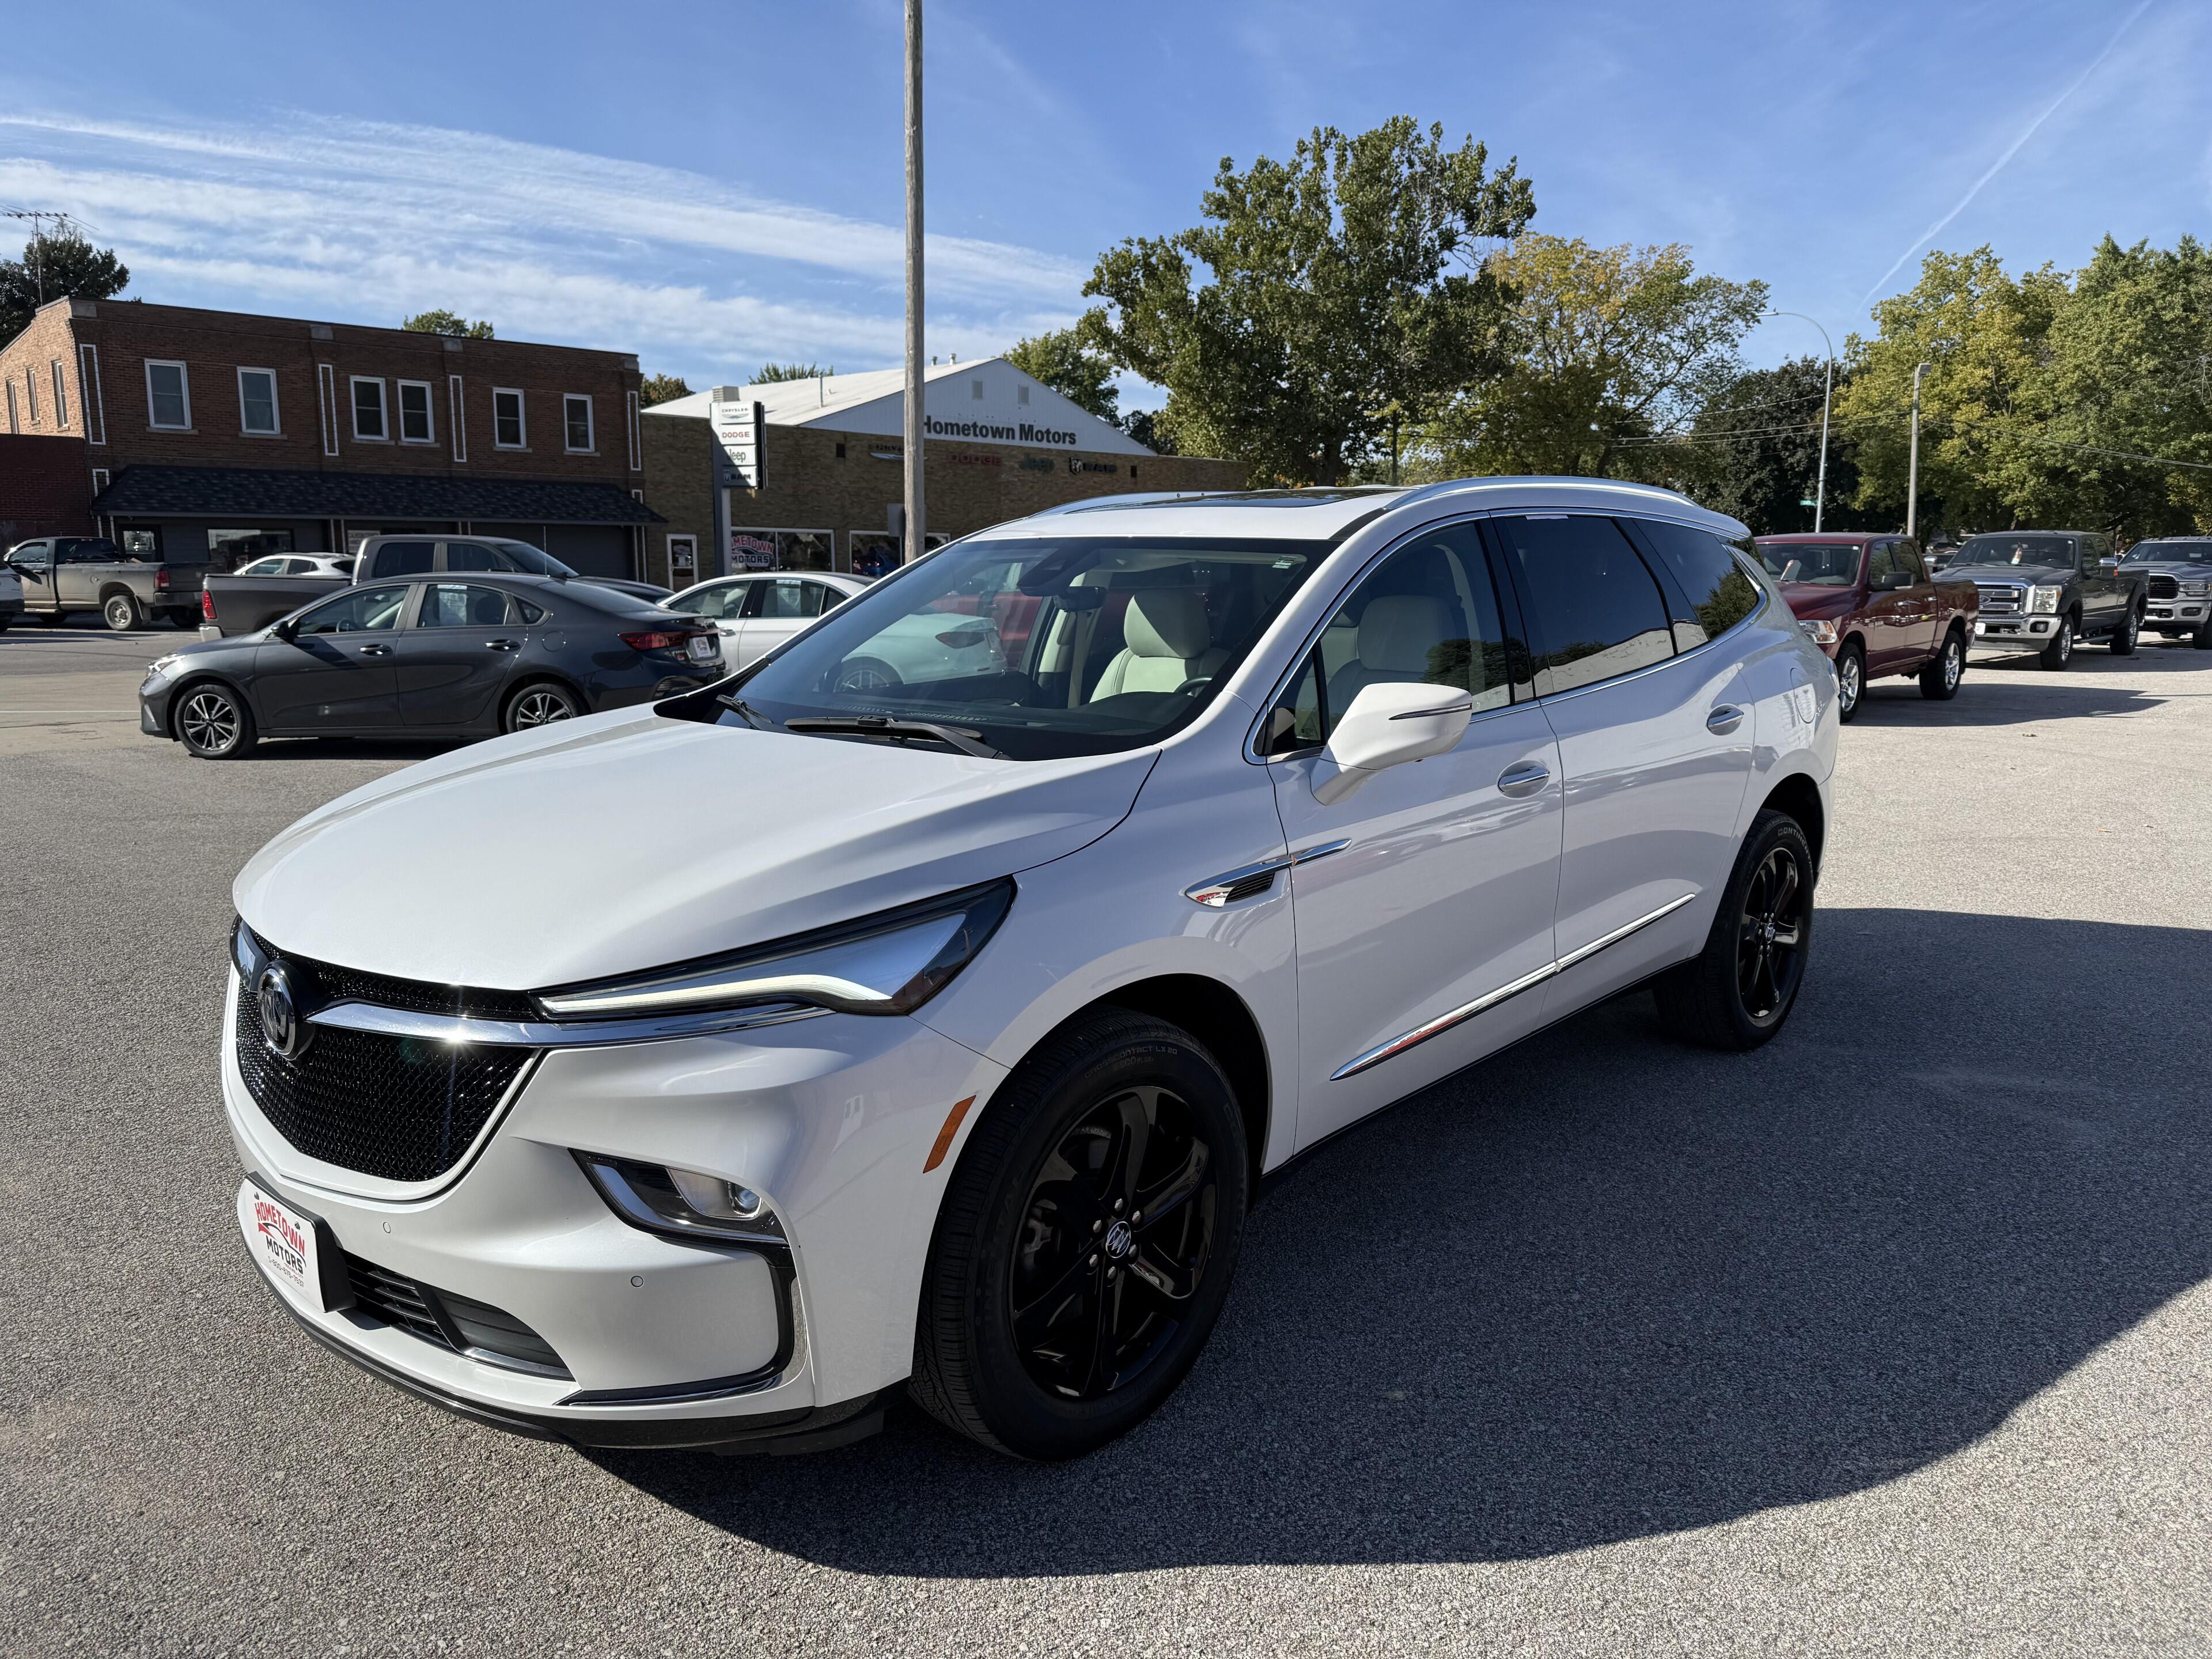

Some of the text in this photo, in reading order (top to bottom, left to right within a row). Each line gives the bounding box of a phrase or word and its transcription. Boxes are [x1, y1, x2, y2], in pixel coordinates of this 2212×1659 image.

[924, 415, 1077, 445] Hometown Motors
[728, 448, 746, 463] Jeep
[732, 536, 774, 553] METOWN
[732, 555, 769, 563] MOTORS
[255, 1202, 305, 1257] HOMETOWN
[266, 1235, 303, 1274] MOTORS
